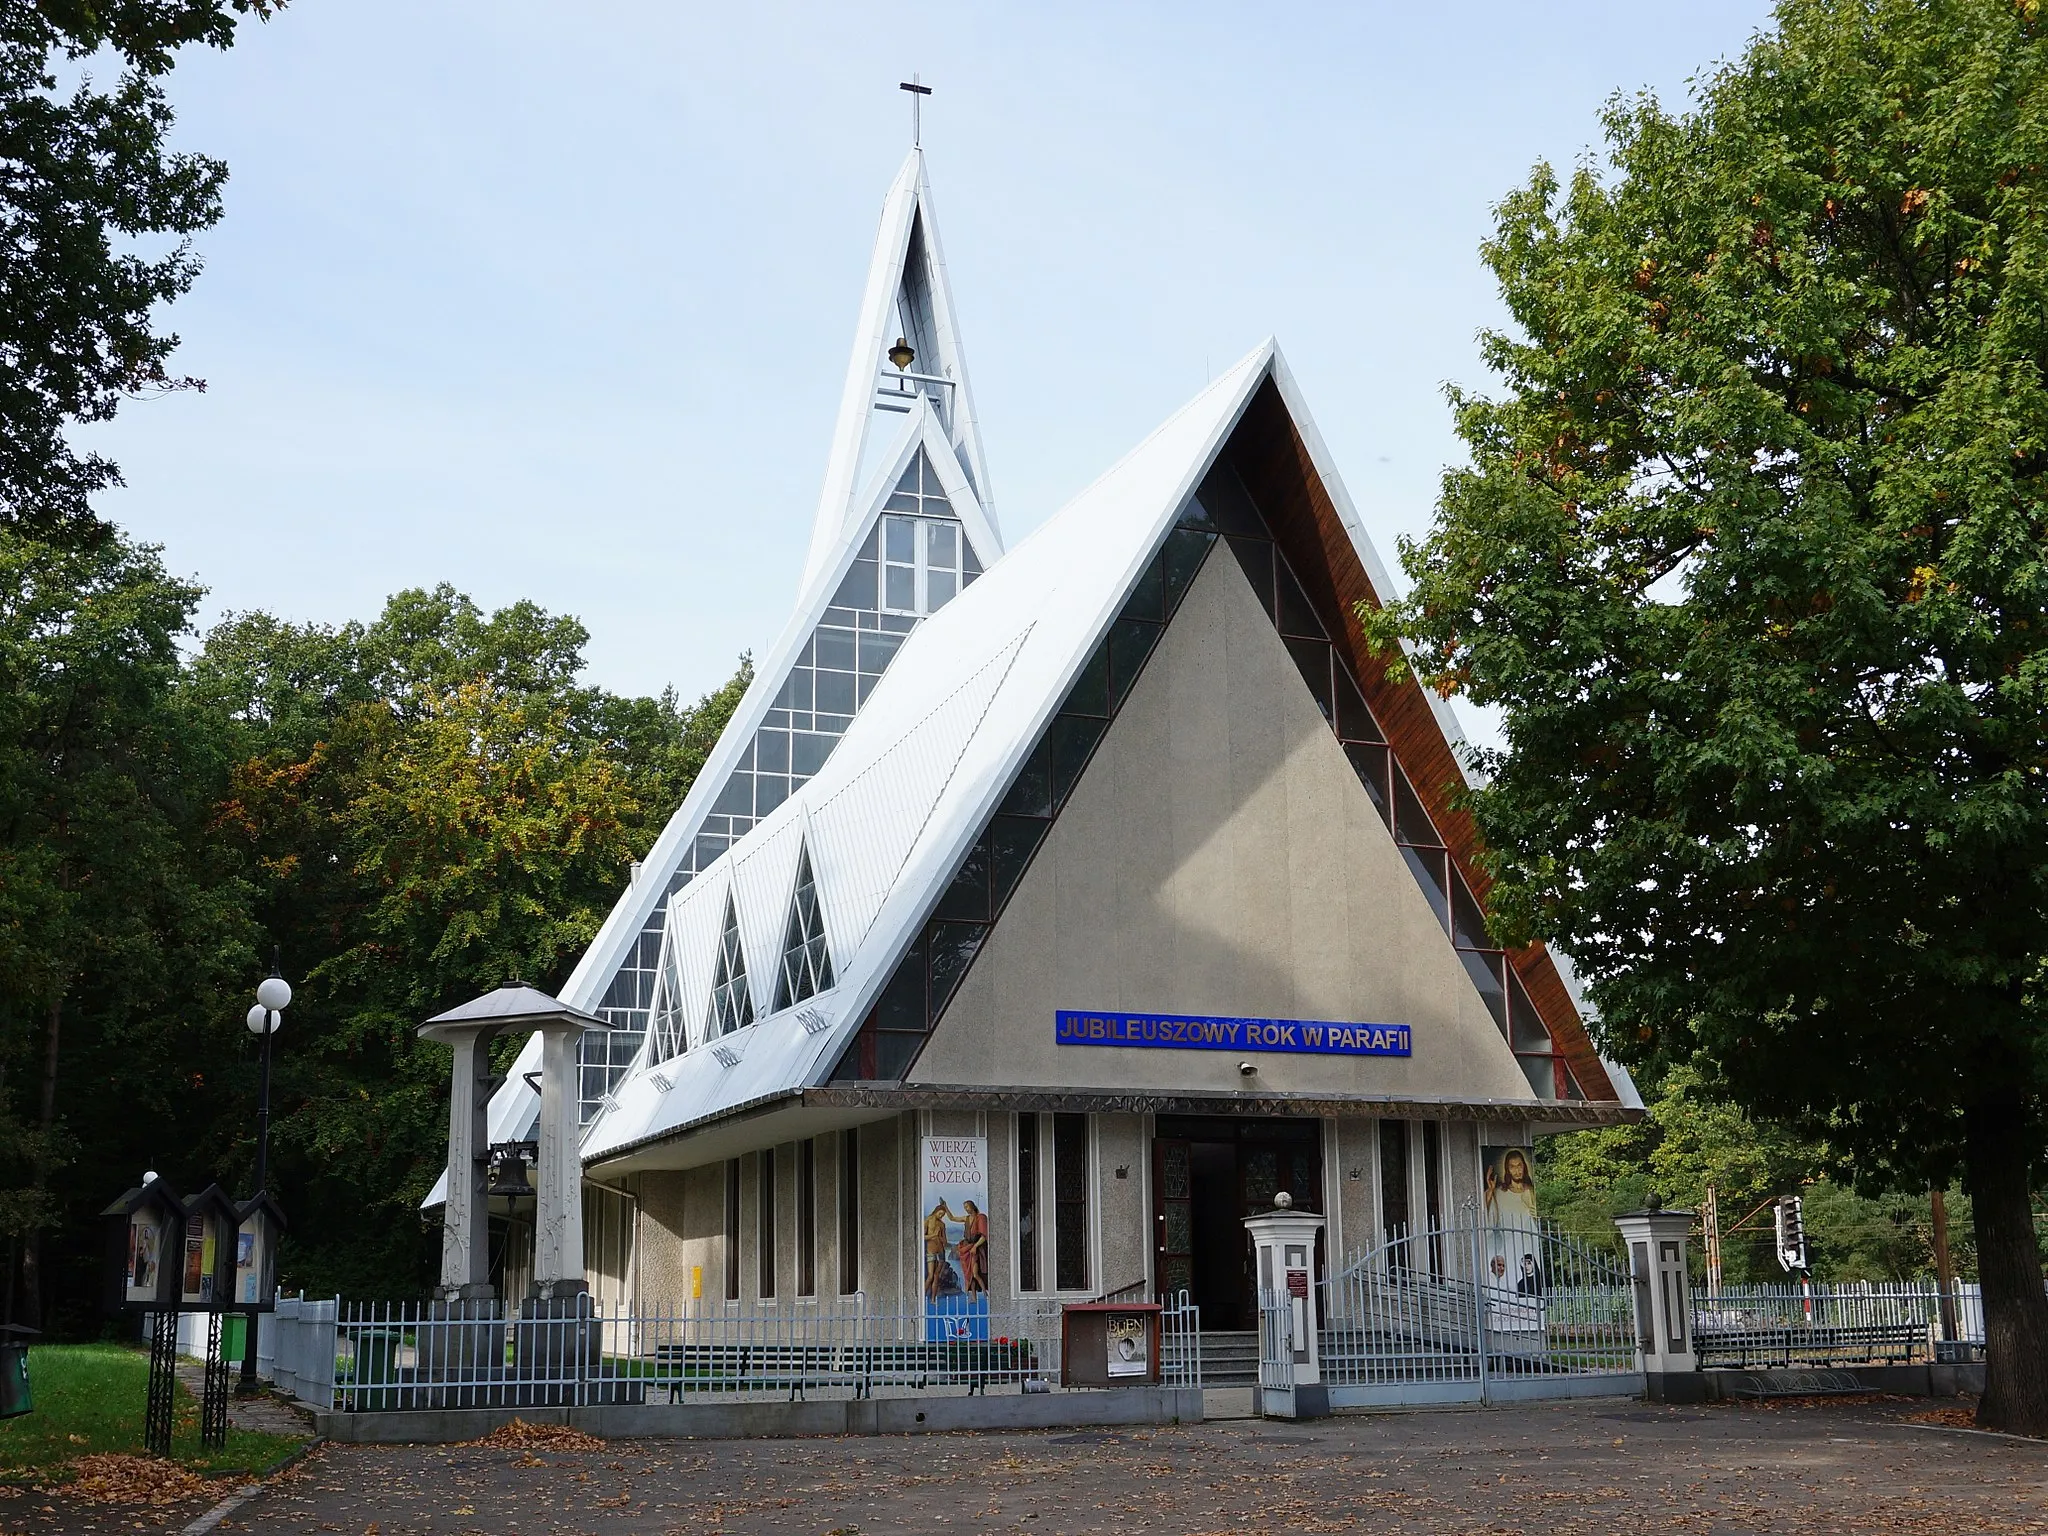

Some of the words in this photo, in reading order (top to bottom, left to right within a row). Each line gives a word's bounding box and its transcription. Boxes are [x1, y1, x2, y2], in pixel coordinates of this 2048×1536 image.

[1060, 1017, 1240, 1044] JUBILEUSZOWY
[1247, 1024, 1296, 1046] ROK
[1301, 1027, 1324, 1047] W
[1328, 1028, 1409, 1050] PARAFII
[929, 1141, 977, 1156] WIERZĘ
[930, 1156, 942, 1168] W
[945, 1155, 977, 1168] SYNA
[929, 1169, 981, 1184] BOŻEGO
